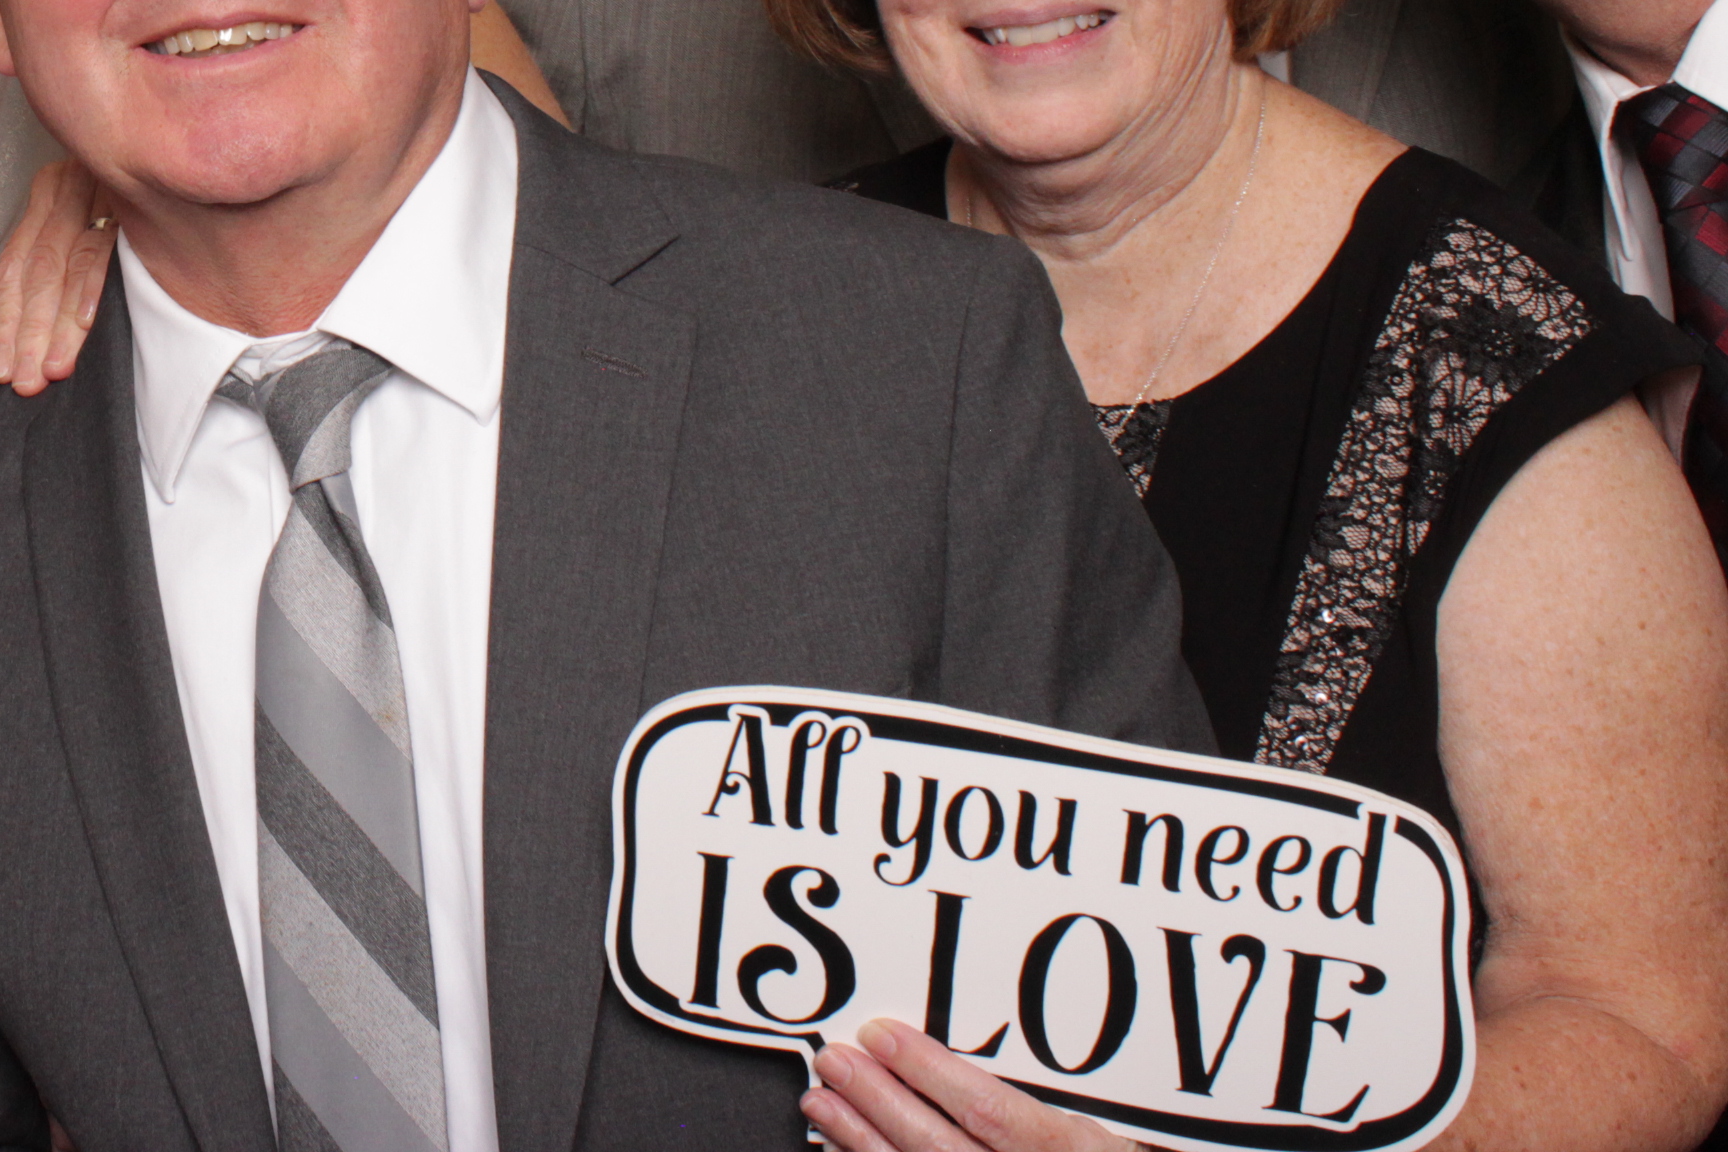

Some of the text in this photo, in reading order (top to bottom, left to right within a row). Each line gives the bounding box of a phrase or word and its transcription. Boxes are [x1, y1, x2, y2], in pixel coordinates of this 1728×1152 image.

[702, 713, 1388, 926] All you need
[686, 851, 1388, 1124] IS LOVE
